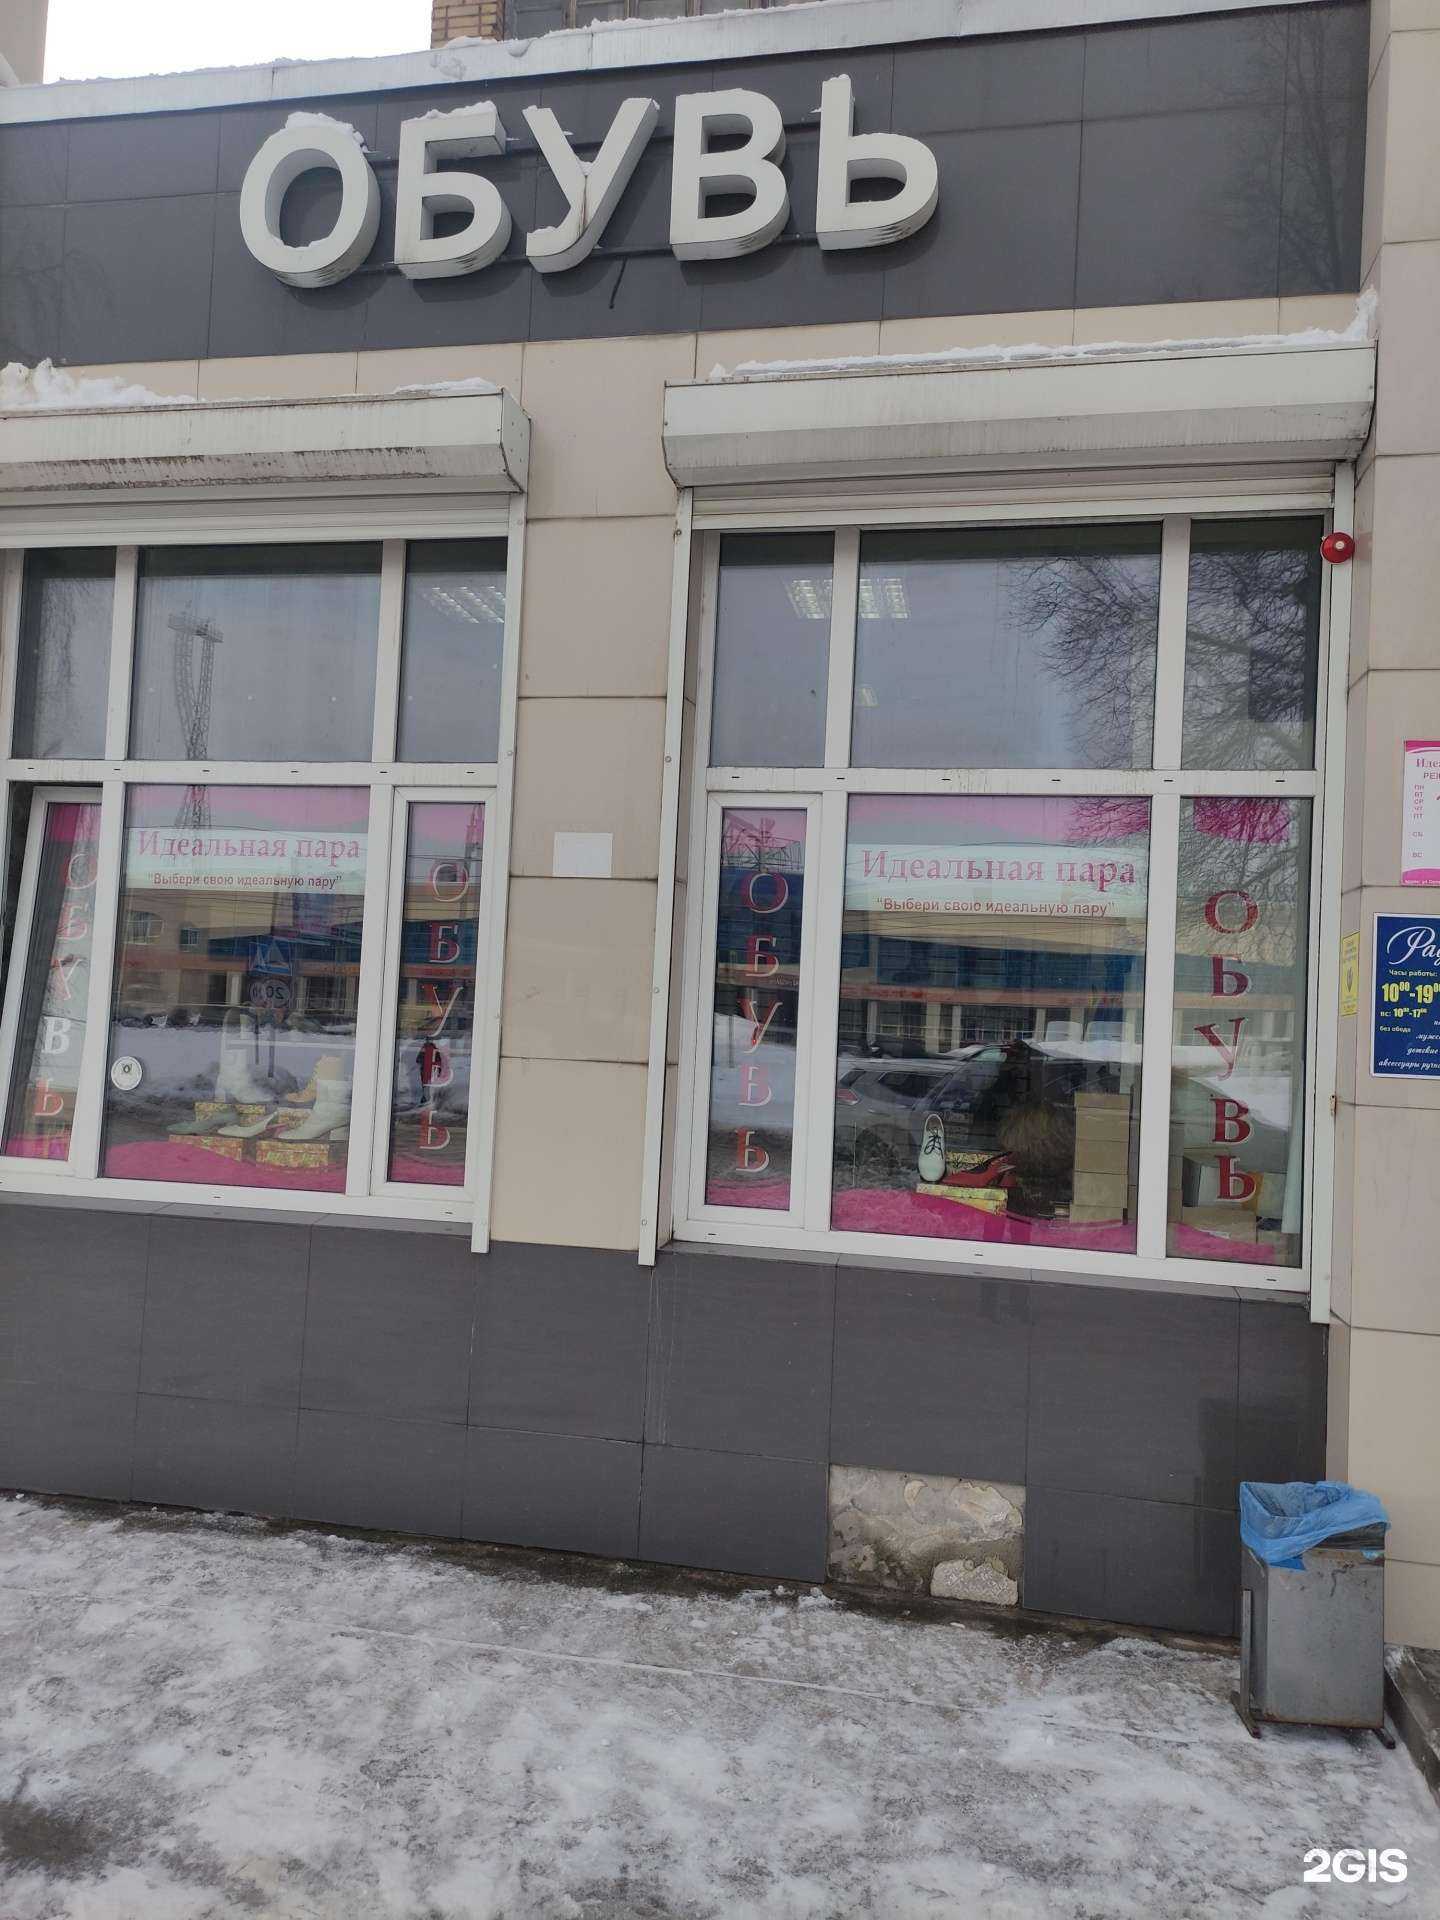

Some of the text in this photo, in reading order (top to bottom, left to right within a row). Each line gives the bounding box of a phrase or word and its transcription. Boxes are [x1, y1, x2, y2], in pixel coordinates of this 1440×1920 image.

[240, 76, 938, 287] ОБУВЬ
[138, 831, 360, 867] Идеальная пара
[203, 876, 234, 886] свою
[237, 876, 304, 889] идеальную
[862, 850, 1137, 892] Идеальная пара
[944, 900, 981, 912] свою
[985, 901, 1069, 916] идеальную
